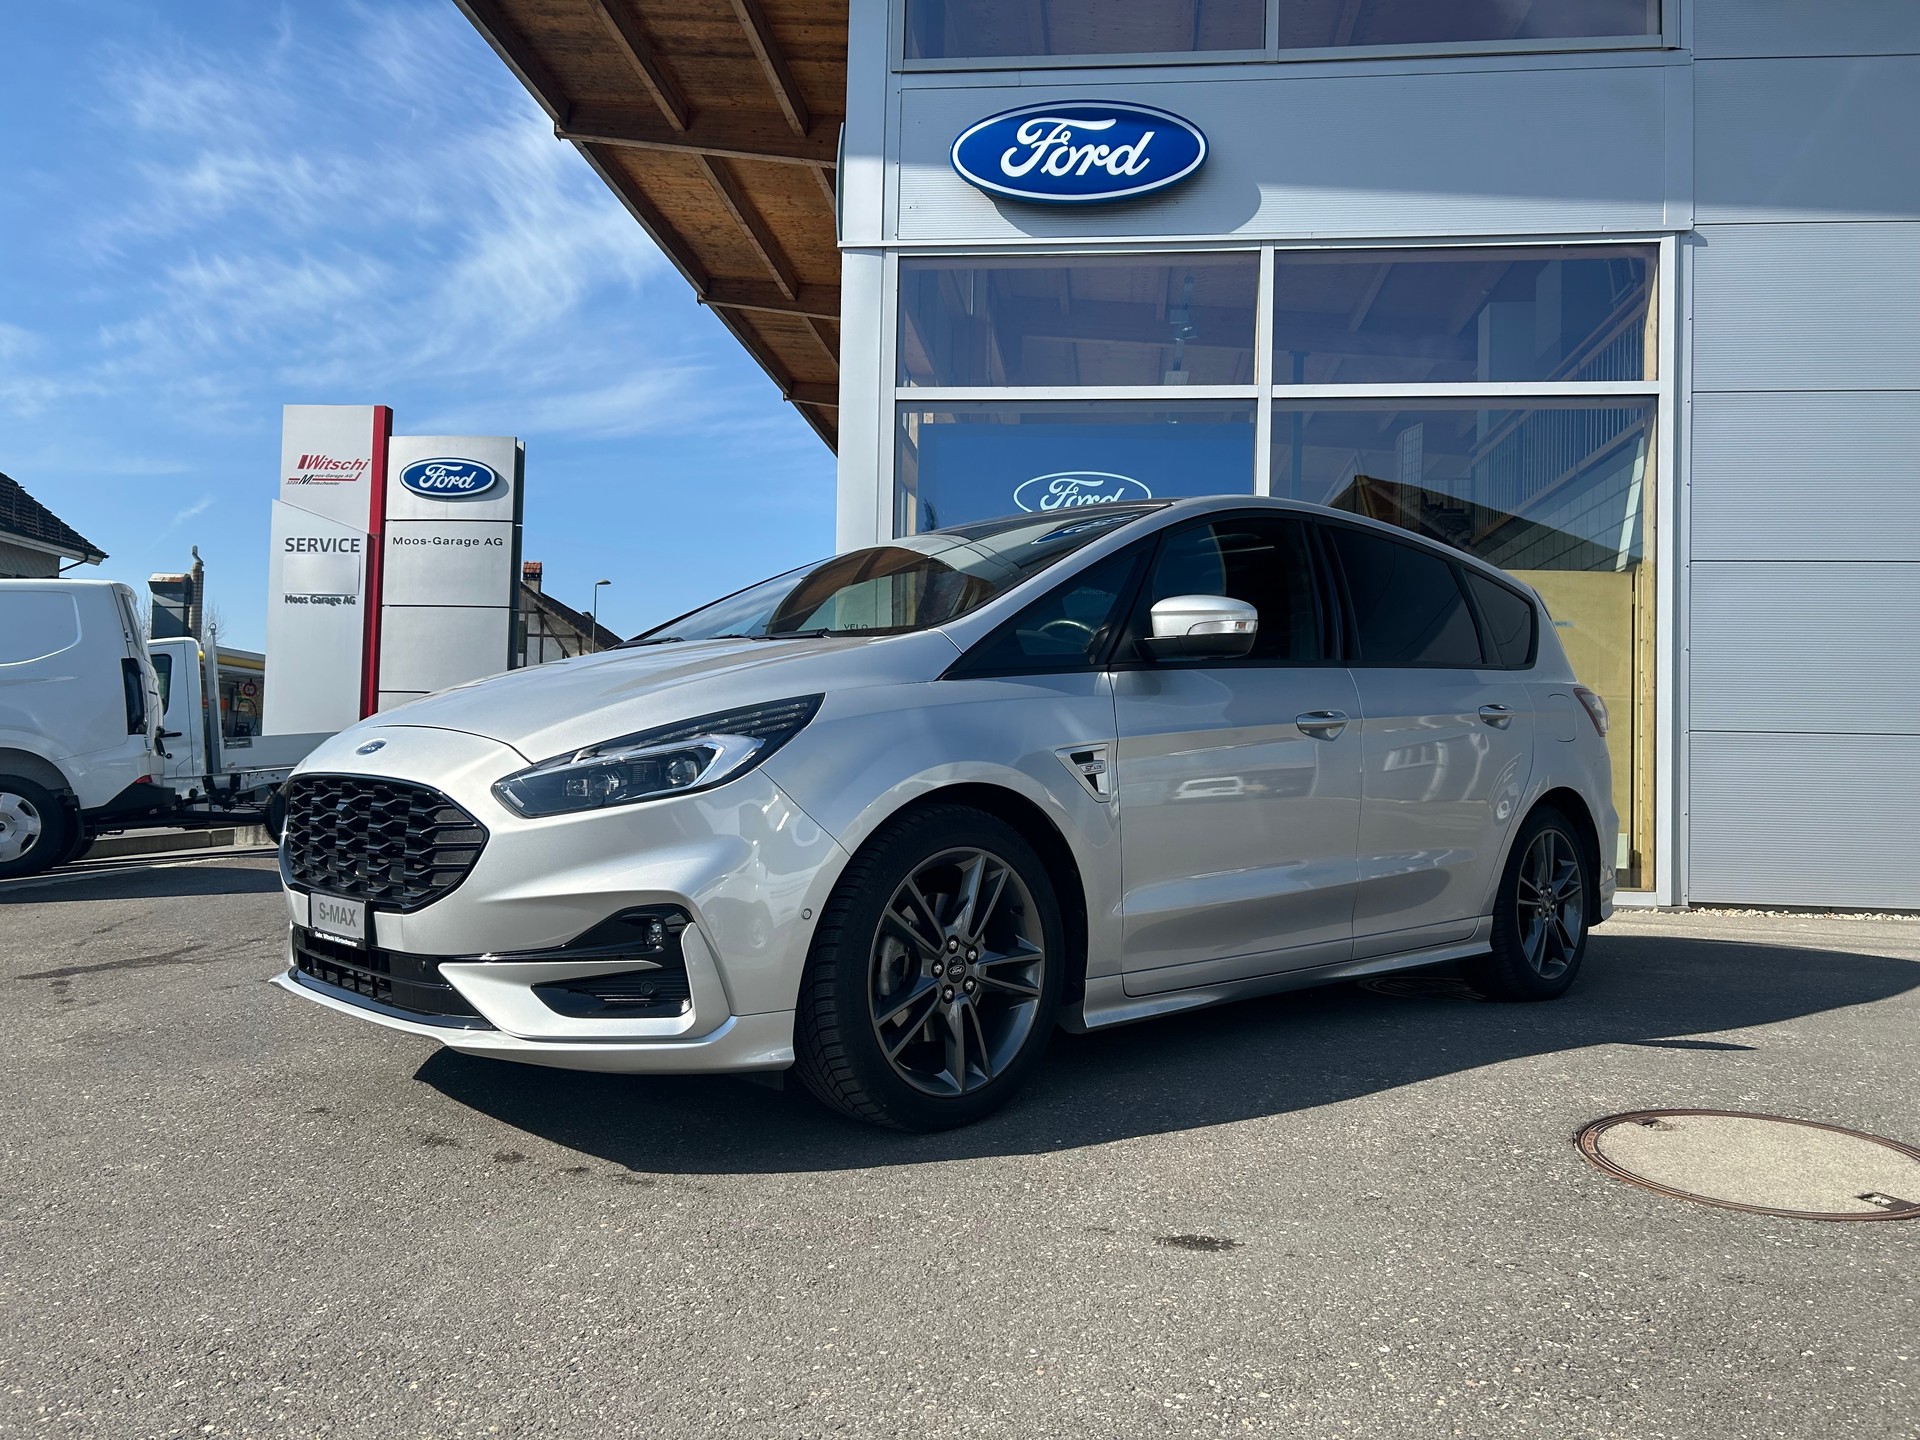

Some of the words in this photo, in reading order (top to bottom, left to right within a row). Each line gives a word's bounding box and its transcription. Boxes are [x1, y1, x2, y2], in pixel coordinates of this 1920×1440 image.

[1000, 117, 1155, 177] Ford
[306, 455, 371, 470] Witschi
[419, 464, 477, 489] Ford
[284, 537, 361, 553] SERVICE
[392, 536, 480, 548] Moos-Garage
[484, 537, 503, 546] AG
[284, 594, 309, 604] Moos
[309, 595, 342, 606] Garage
[342, 596, 356, 605] AG
[319, 902, 357, 928] S-MAX
